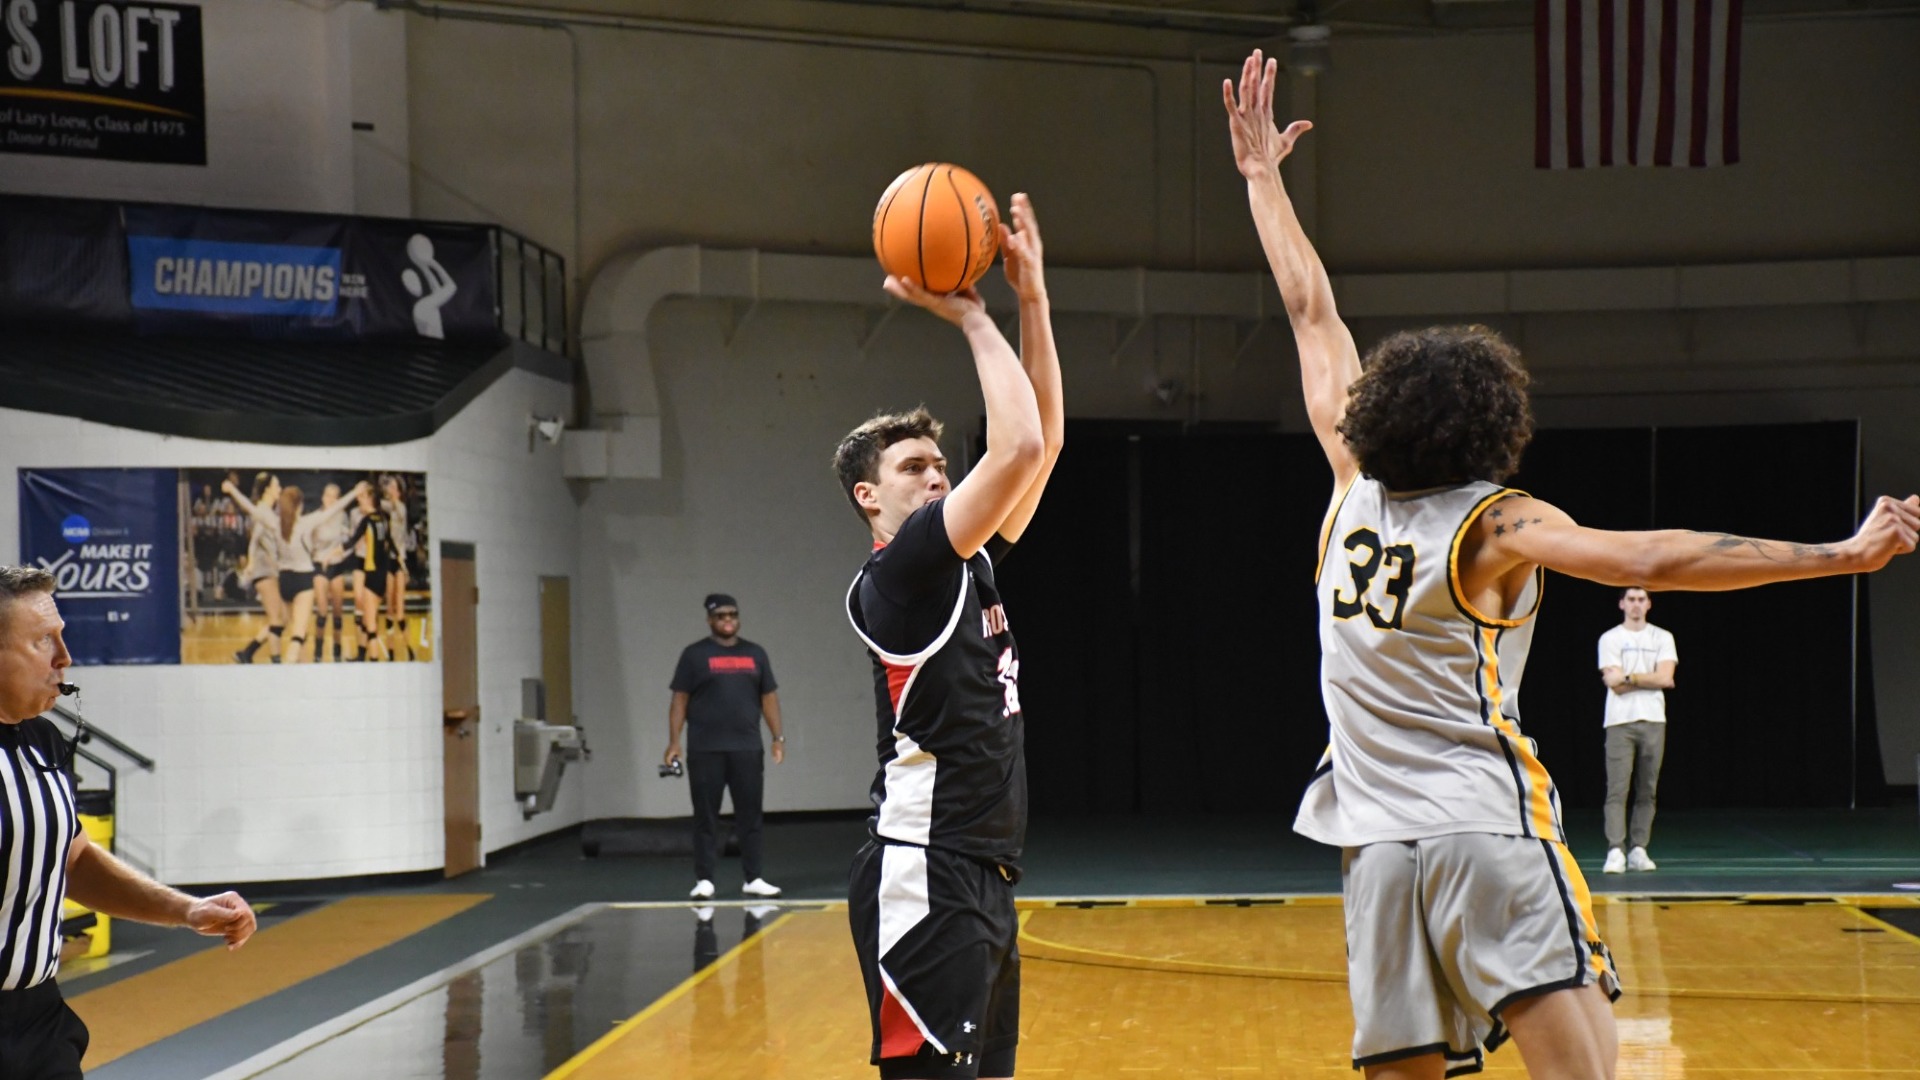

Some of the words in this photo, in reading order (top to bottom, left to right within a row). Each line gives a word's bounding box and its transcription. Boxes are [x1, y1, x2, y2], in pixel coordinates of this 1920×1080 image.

[59, 0, 181, 92] LOFT
[0, 107, 13, 124] of
[16, 109, 48, 127] Lary
[94, 114, 131, 132] Class
[133, 119, 149, 134] of
[152, 120, 186, 136] 1975
[7, 130, 44, 145] Donor
[47, 133, 58, 147] &
[61, 133, 100, 150] Friend
[154, 256, 335, 302] CHAMPIONS
[36, 549, 152, 592] YOURS
[79, 544, 131, 559] MAKE
[134, 544, 153, 559] IT
[1333, 526, 1416, 630] 33
